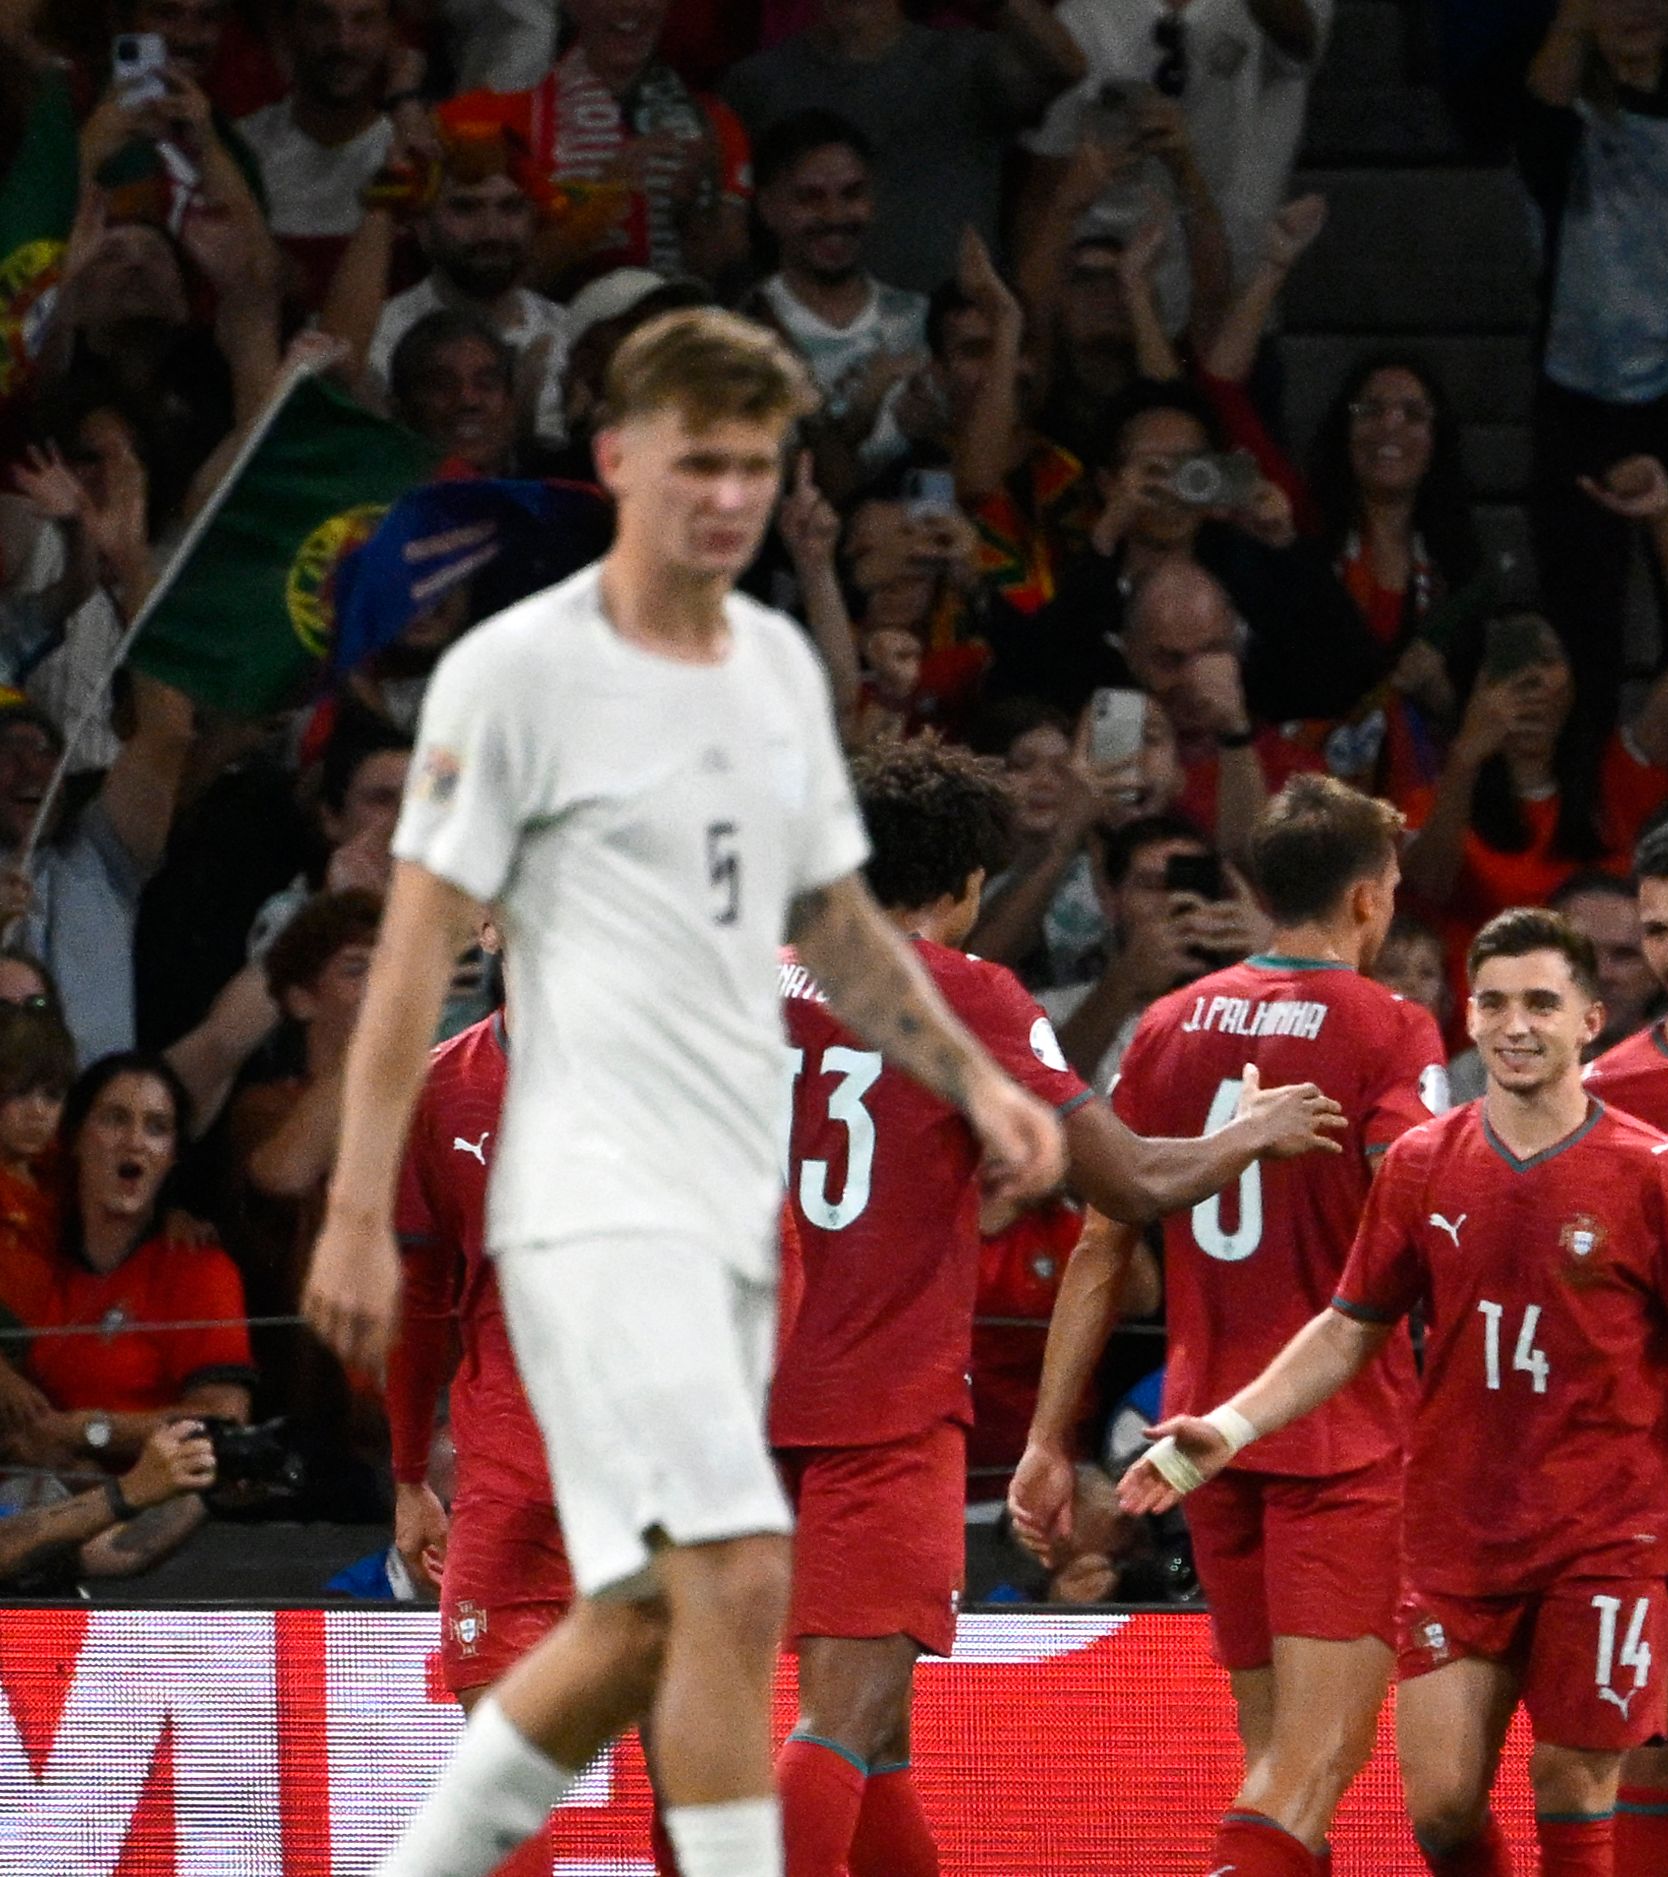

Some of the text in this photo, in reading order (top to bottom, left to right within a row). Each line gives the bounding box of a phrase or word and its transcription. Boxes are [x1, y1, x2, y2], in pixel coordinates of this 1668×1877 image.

[706, 821, 740, 926] 5
[1477, 1299, 1550, 1393] 14
[1591, 1594, 1652, 1688] 14
